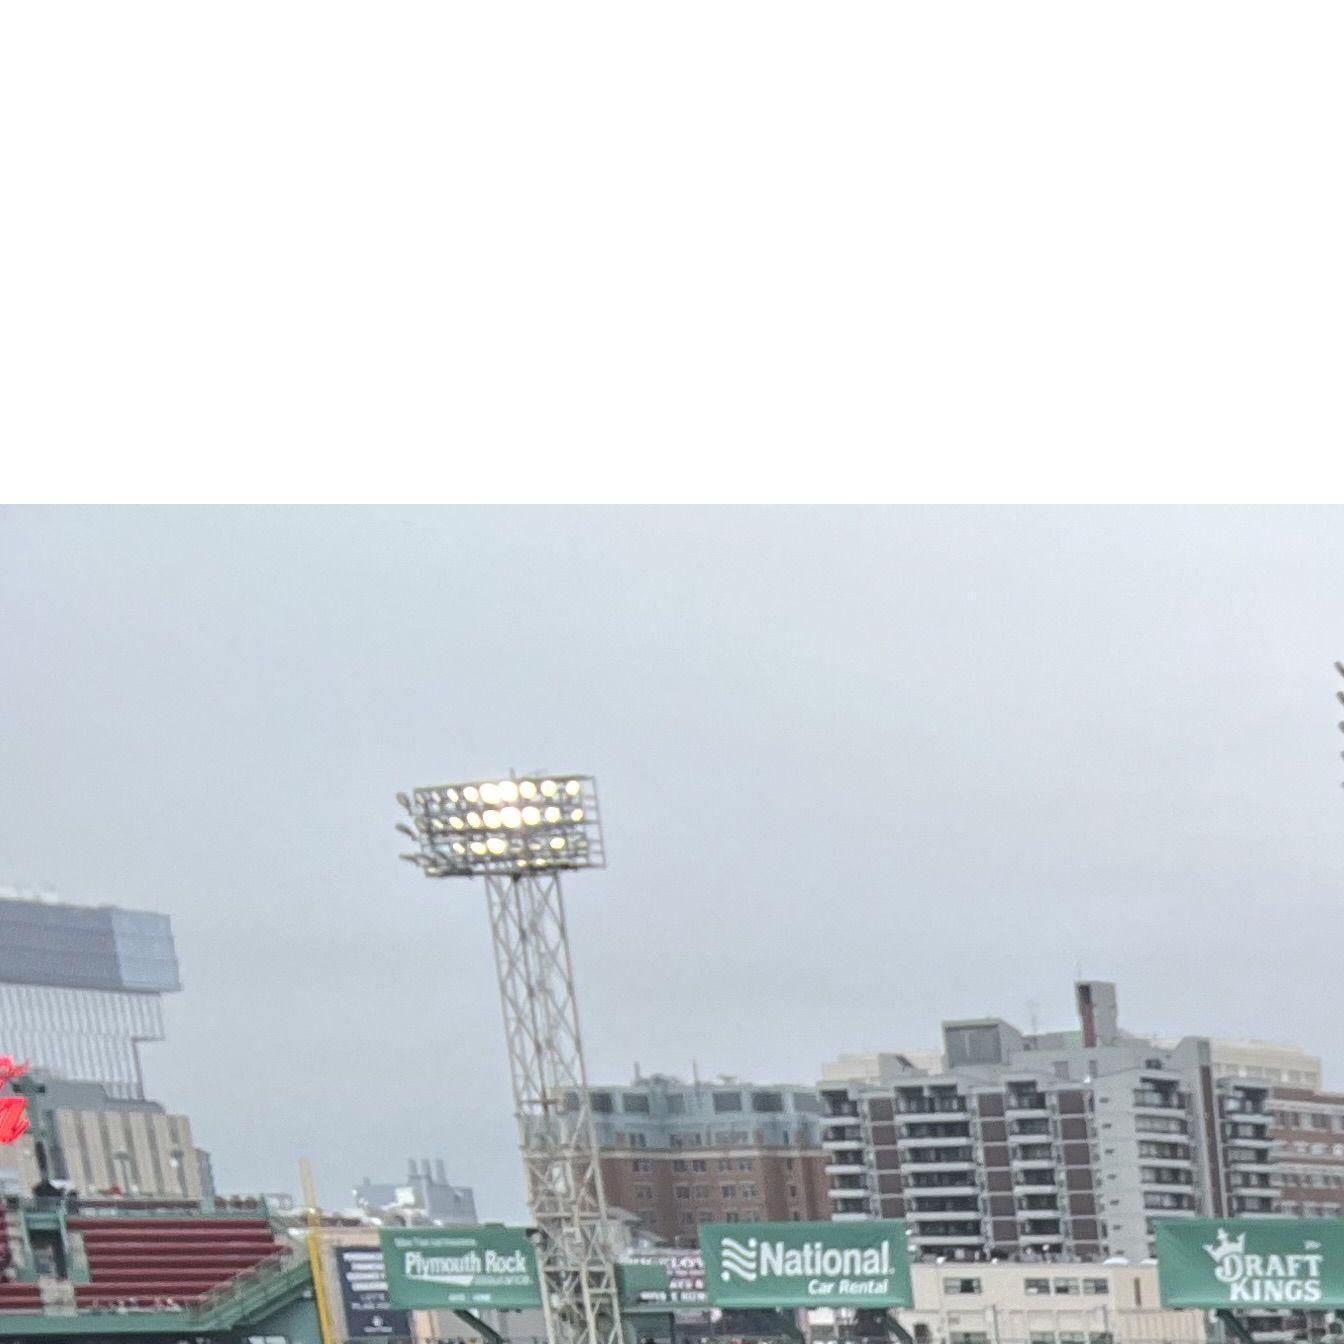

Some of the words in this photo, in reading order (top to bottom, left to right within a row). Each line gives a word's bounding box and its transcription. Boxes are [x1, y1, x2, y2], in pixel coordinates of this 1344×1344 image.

[404, 1250, 481, 1277] Plymouth
[484, 1249, 526, 1273] Rock
[760, 1239, 889, 1278] National
[1214, 1252, 1324, 1284] DRAFT
[808, 1279, 836, 1295] Car
[838, 1278, 889, 1295] Rental
[1228, 1278, 1323, 1302] KINGS
